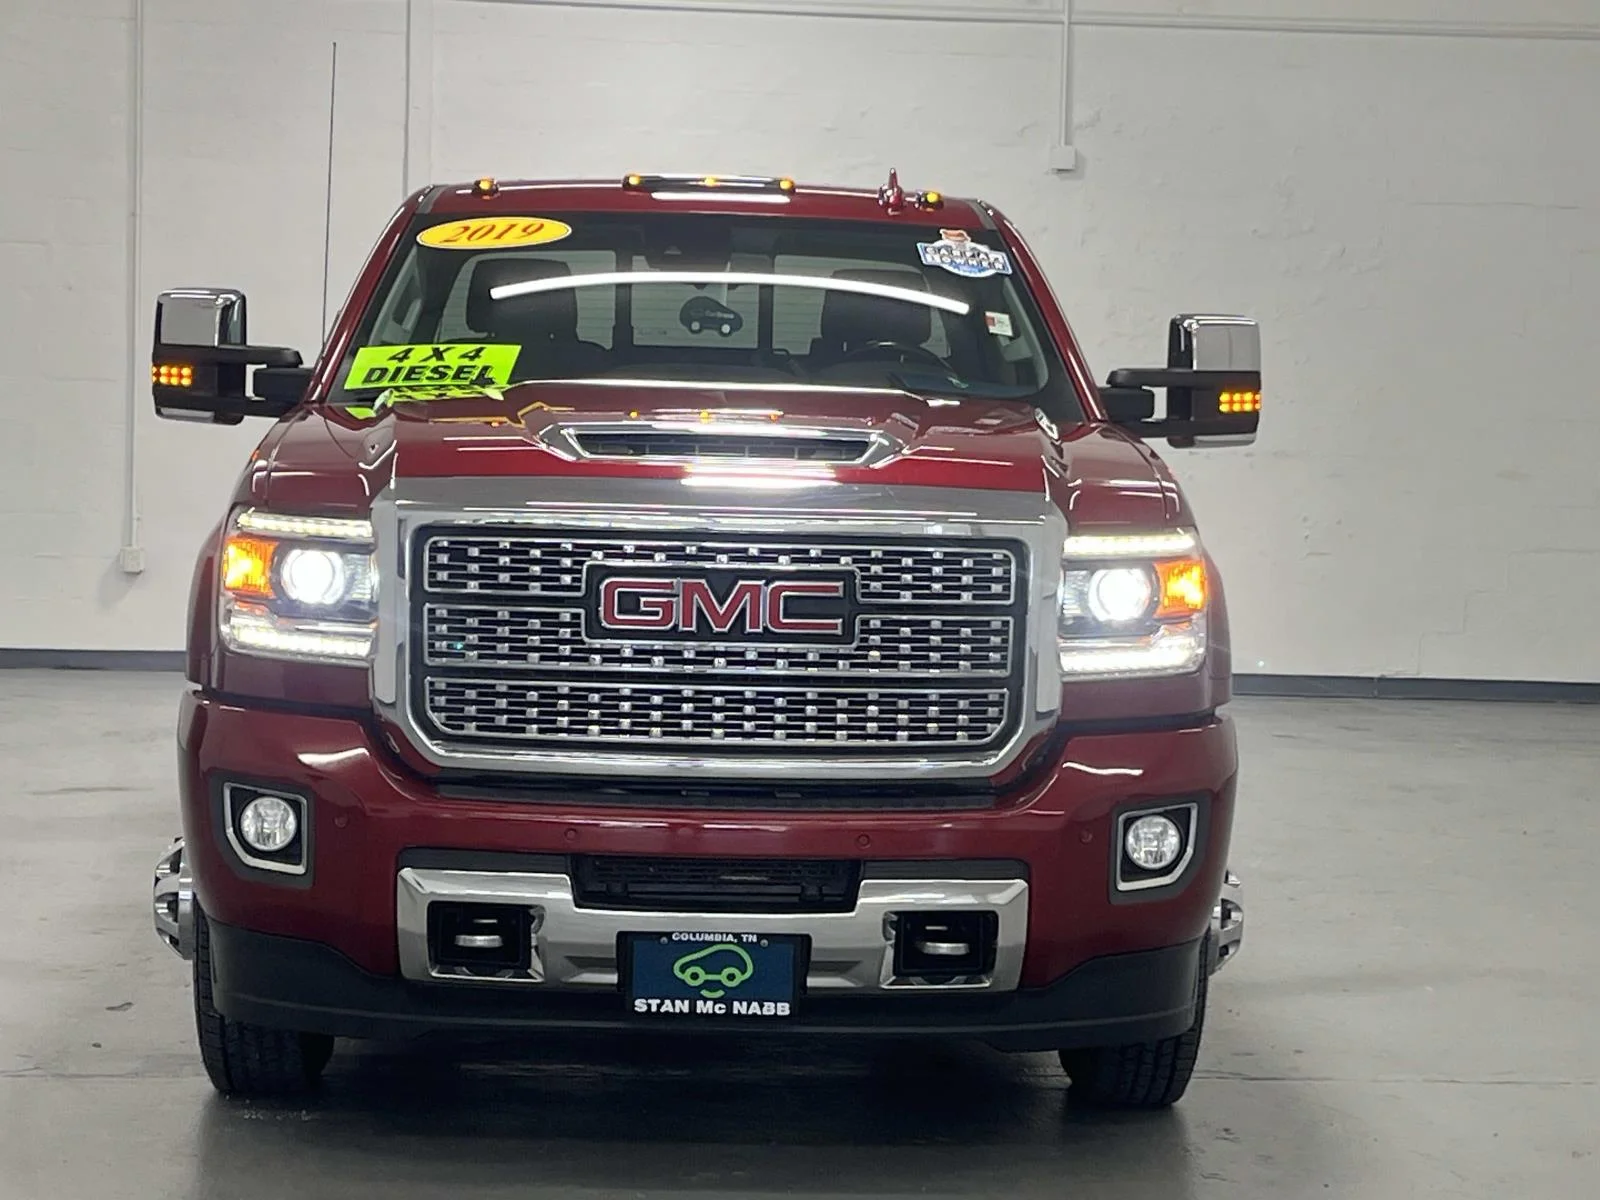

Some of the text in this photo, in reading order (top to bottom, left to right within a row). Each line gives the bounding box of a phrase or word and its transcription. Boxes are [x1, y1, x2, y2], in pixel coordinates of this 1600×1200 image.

[439, 223, 544, 243] 2019
[361, 365, 495, 386] DIESEL
[601, 578, 844, 633] GMC
[671, 932, 757, 943] COLUMBIA, TN
[634, 998, 791, 1016] STAN Mc NABB
